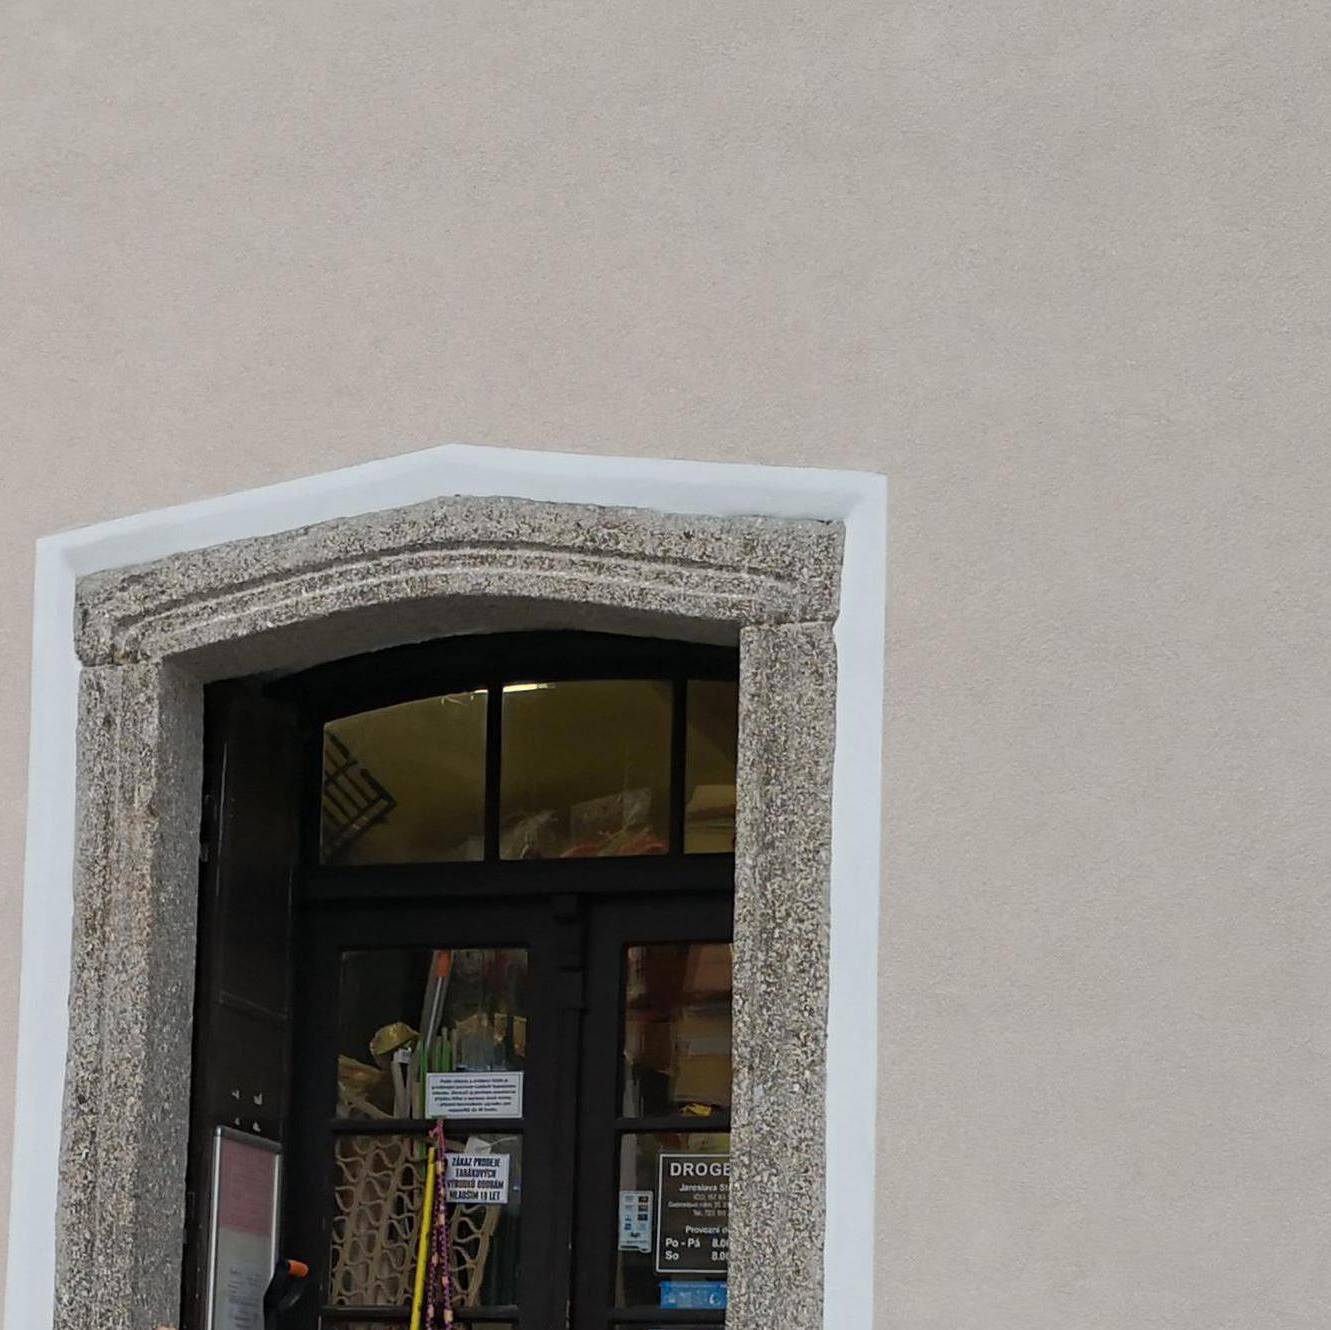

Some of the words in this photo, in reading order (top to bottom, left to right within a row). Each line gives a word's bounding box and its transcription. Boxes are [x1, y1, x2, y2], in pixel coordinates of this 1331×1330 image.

[665, 1238, 678, 1247] Po
[688, 1238, 701, 1248] Pá
[665, 1250, 679, 1260] So
